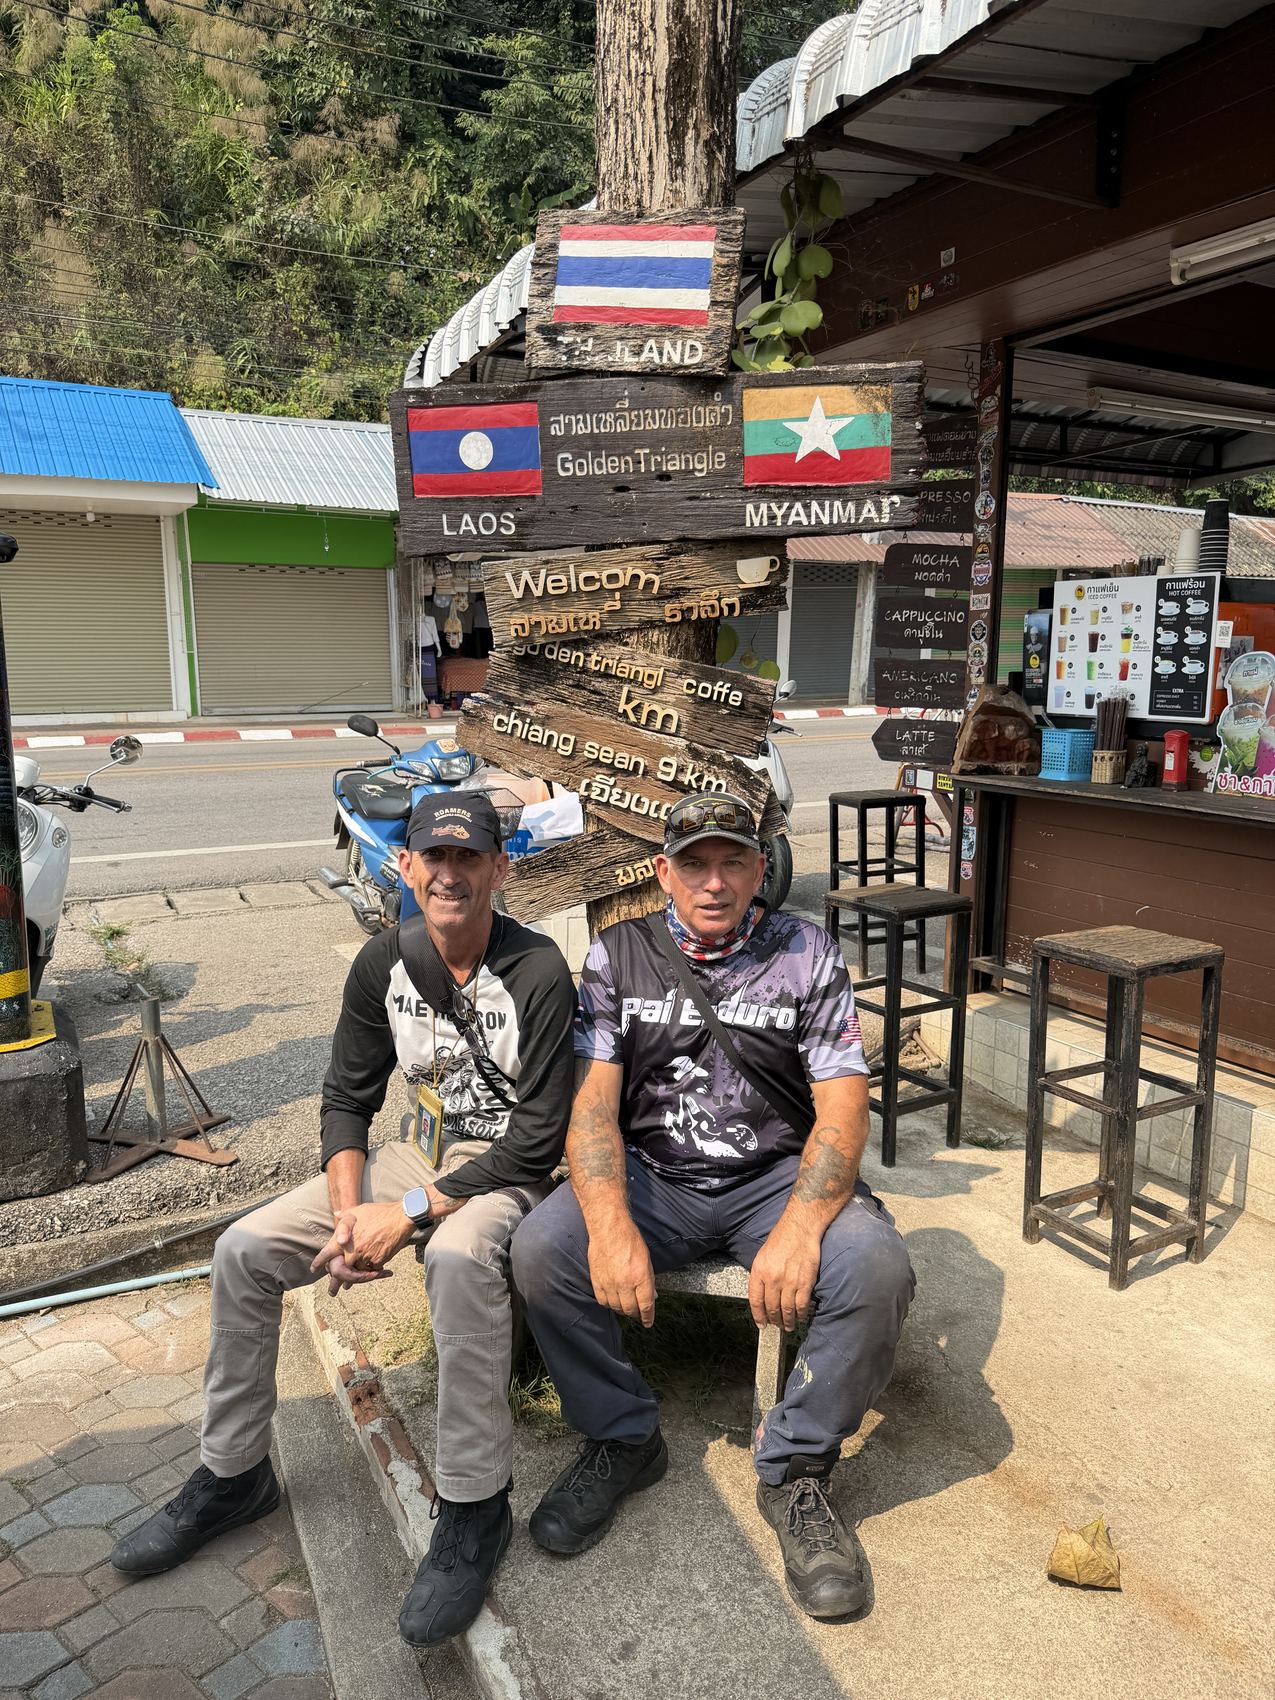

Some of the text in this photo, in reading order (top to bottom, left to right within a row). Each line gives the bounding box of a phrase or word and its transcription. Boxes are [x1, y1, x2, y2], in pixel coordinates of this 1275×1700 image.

[556, 336, 703, 365] THILAND
[550, 390, 733, 436] สามเหลี่ยมทองคำ
[919, 490, 972, 503] PRESSO
[441, 511, 517, 537] LAOS
[911, 552, 961, 568] MOCHA
[505, 563, 661, 600] Welcom
[1165, 578, 1206, 590] กาแฟร้อน
[884, 609, 966, 624] CAPPUCCINO
[590, 653, 665, 690] triangl
[682, 677, 744, 707] coffe
[881, 669, 959, 684] AMERICANO
[617, 687, 681, 733] km
[895, 730, 936, 742] LATTE
[492, 710, 577, 750] chiang
[583, 739, 646, 776] sean
[684, 764, 728, 795] km
[433, 806, 472, 820] ROAMERS
[392, 994, 428, 1018] MAE
